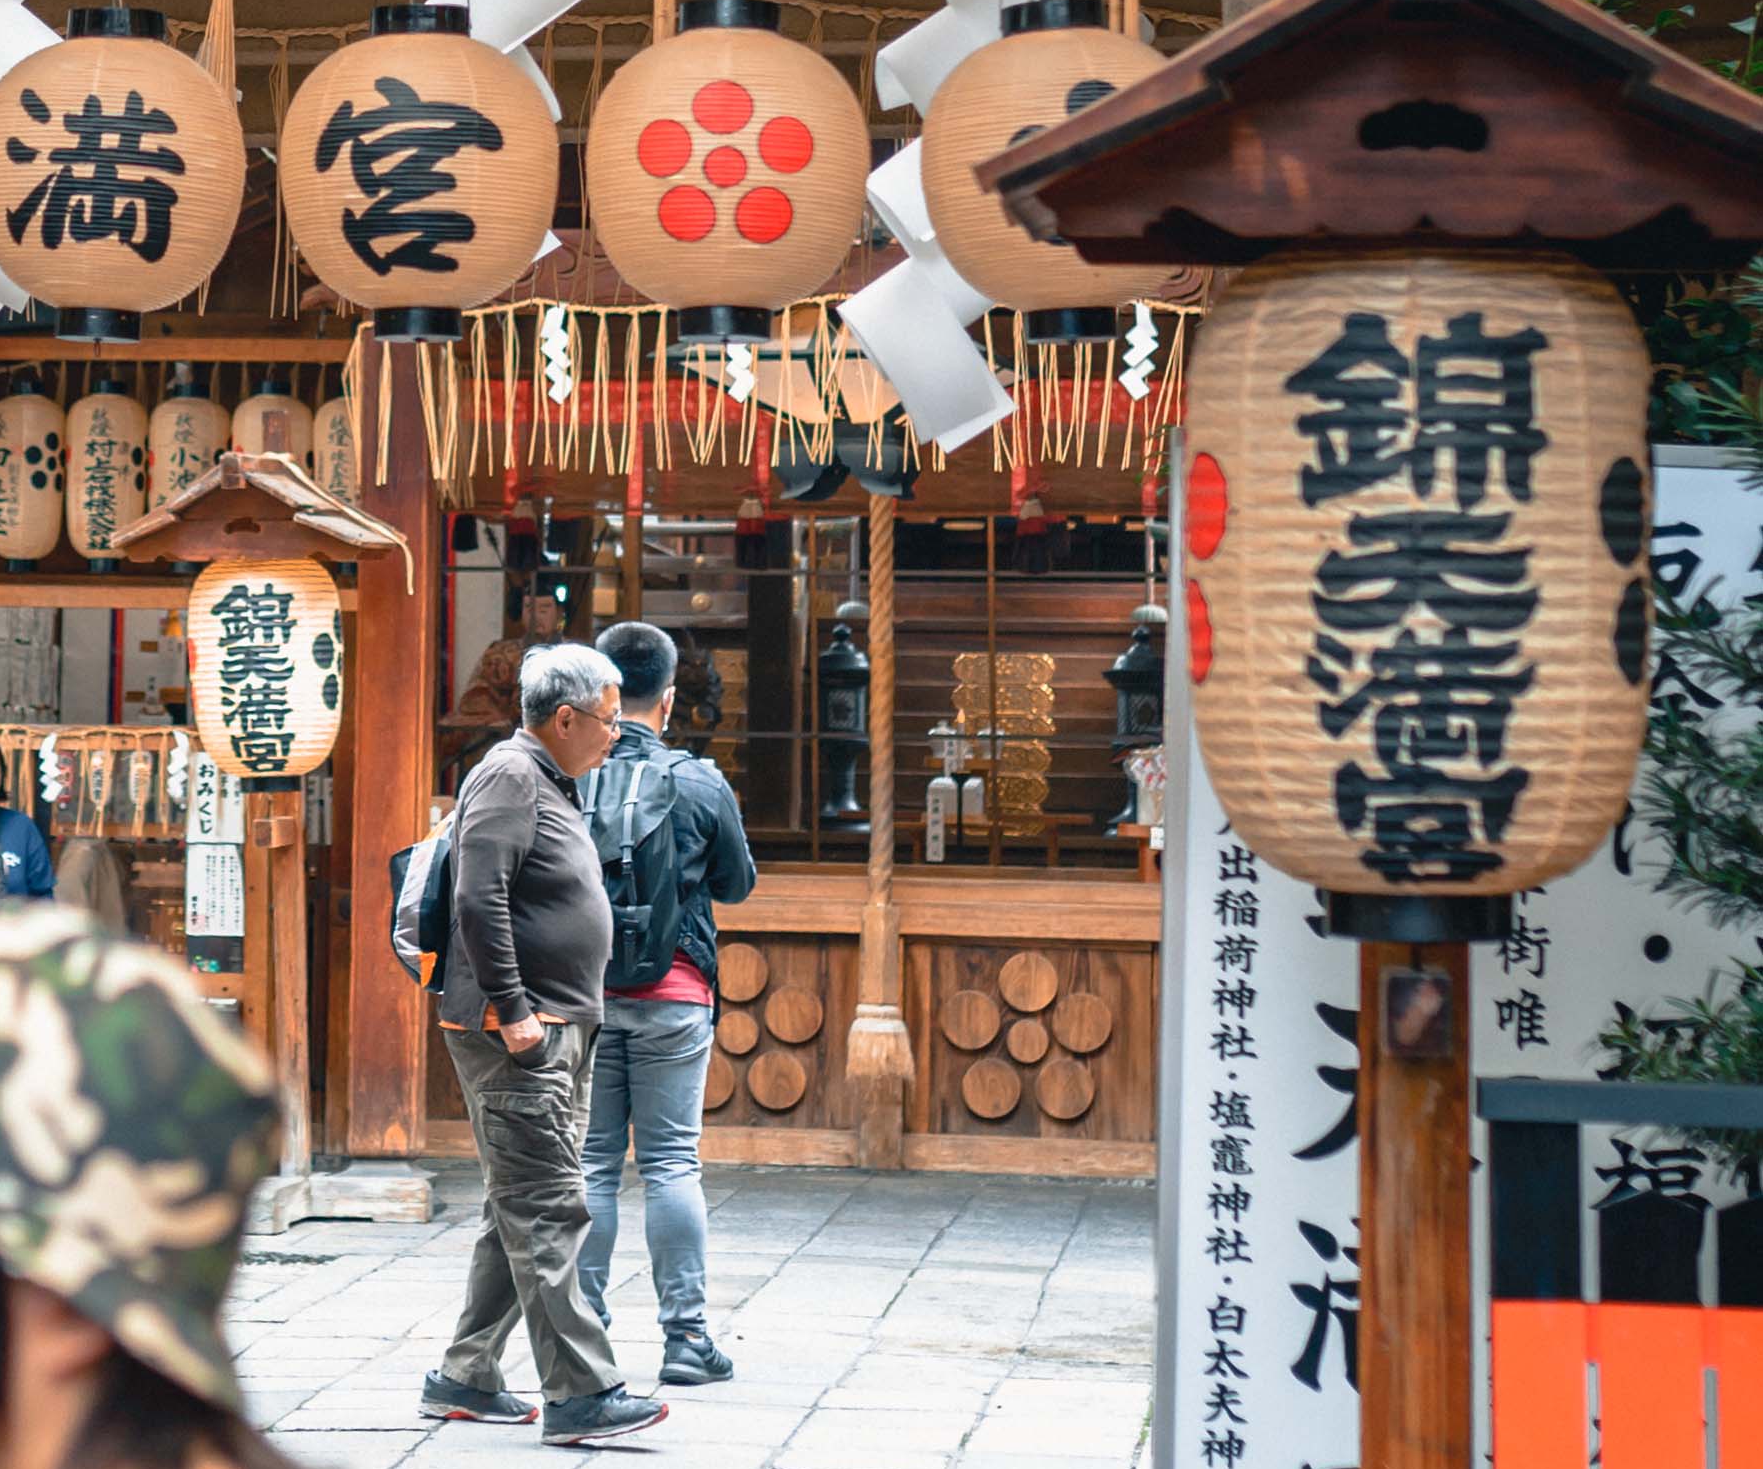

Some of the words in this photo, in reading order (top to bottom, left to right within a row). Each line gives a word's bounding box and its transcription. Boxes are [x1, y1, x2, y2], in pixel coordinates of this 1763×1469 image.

[5, 86, 185, 264] 満
[315, 76, 504, 277] 宮
[210, 582, 298, 773] 錦天満宮
[1283, 310, 1551, 886] 錦天満宮
[196, 763, 217, 835] おみくじ
